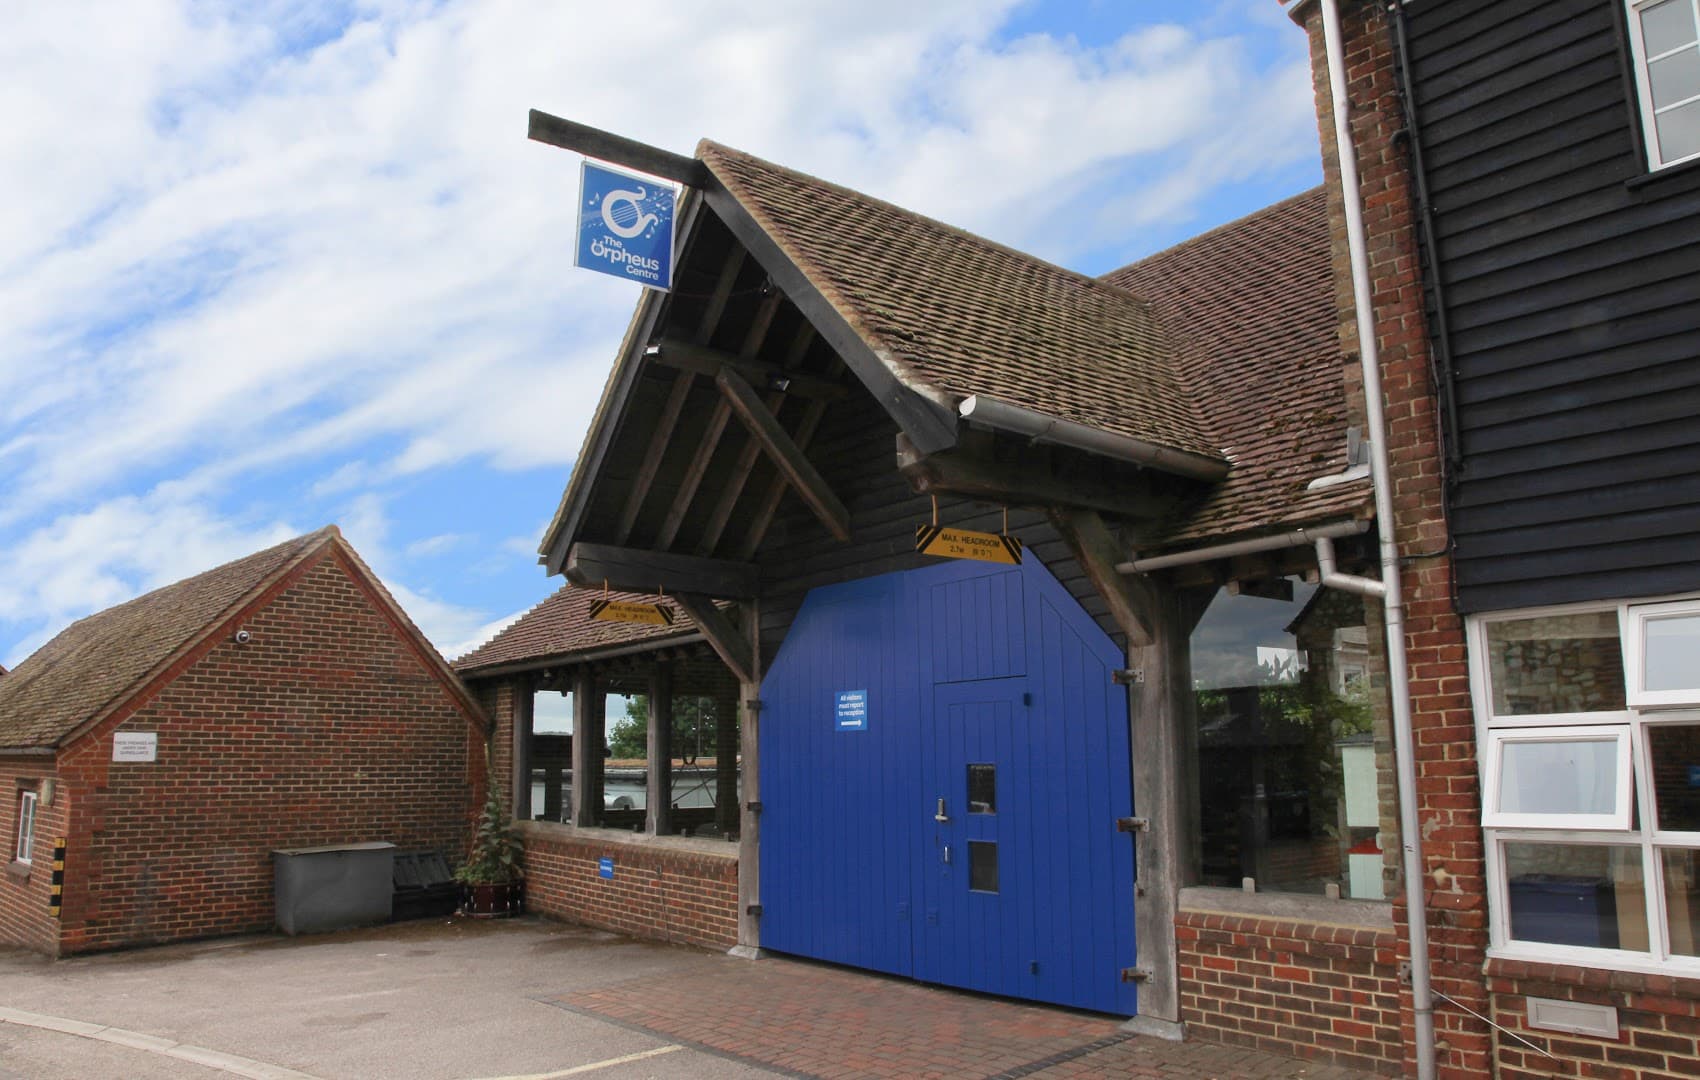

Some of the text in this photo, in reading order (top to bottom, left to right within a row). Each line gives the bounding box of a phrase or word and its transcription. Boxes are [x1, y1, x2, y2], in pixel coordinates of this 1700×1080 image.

[603, 235, 623, 248] The
[590, 238, 659, 271] Orpheus
[626, 265, 659, 280] Centre
[961, 536, 1000, 547] HEADROOM
